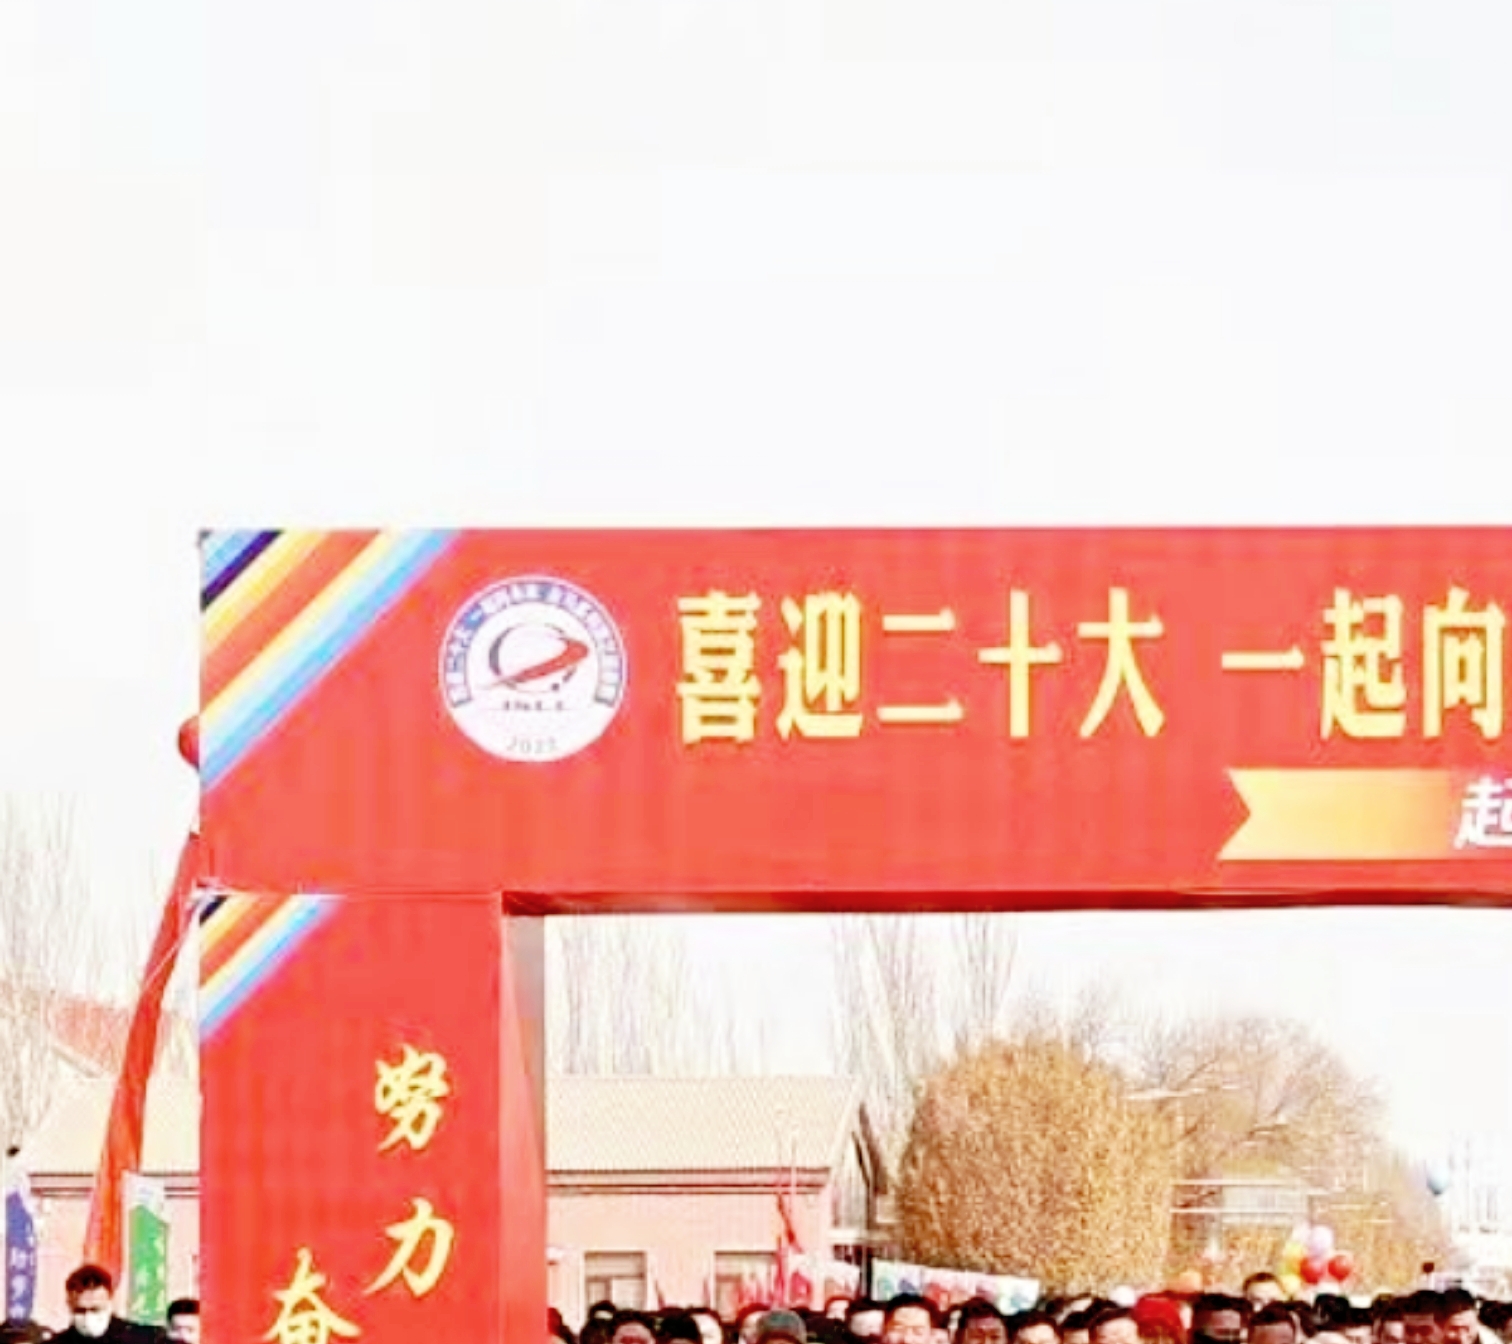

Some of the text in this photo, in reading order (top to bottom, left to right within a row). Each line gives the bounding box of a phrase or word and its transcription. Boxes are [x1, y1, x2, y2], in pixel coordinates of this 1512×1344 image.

[676, 589, 1165, 745] 喜迎二十大
